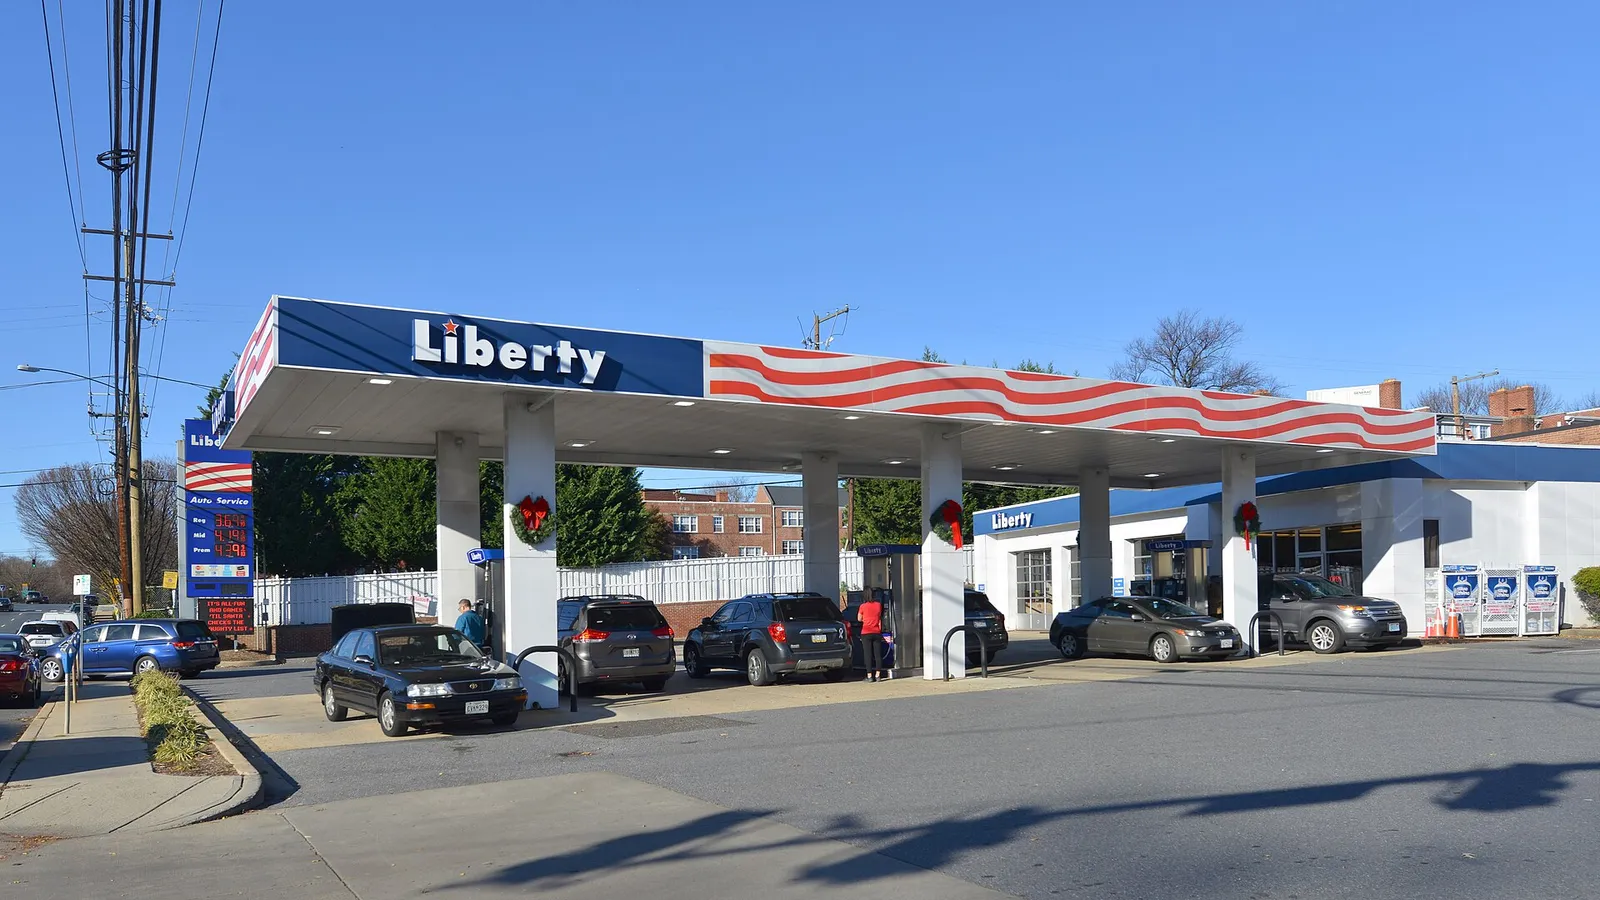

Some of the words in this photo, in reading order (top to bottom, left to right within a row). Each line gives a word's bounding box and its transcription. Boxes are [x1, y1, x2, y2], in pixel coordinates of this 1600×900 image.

[411, 319, 606, 384] Liberty
[191, 434, 220, 446] Libe
[190, 496, 212, 504] Auto
[216, 497, 249, 505] Service
[992, 512, 1031, 530] Liberty
